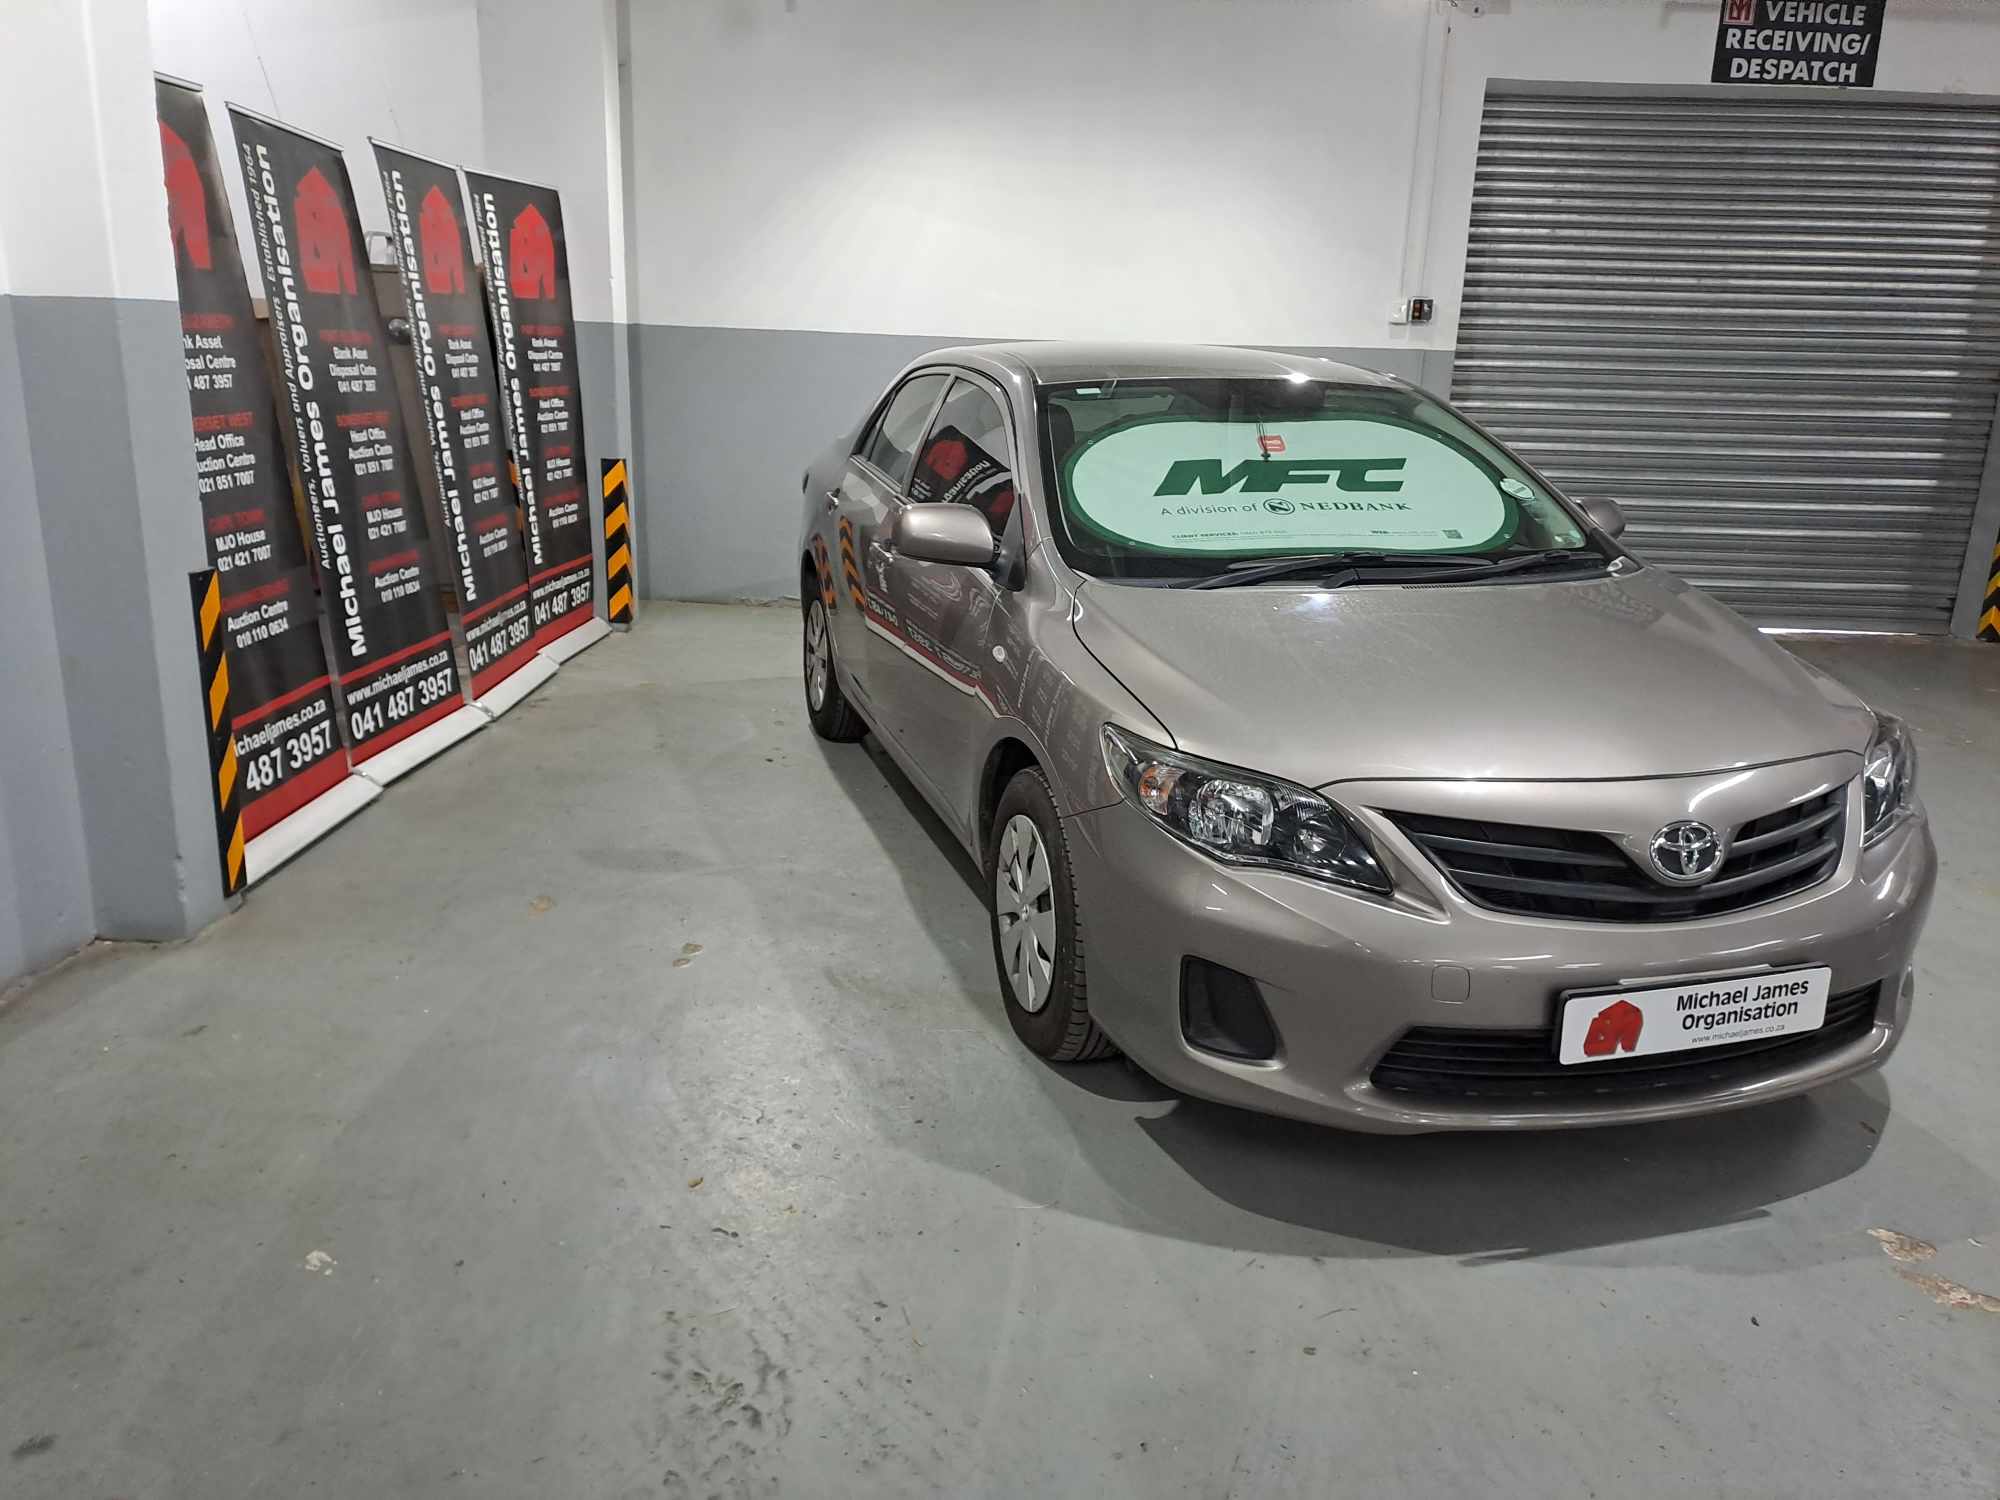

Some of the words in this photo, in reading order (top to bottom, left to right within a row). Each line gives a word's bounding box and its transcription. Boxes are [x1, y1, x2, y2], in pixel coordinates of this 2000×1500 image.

[1766, 1, 1866, 26] VEHICLE
[1725, 28, 1871, 55] RECEIVING/
[1730, 57, 1857, 83] DESPATCH
[251, 191, 276, 282] Established
[256, 144, 314, 390] Organisation
[392, 170, 436, 376] Organisation
[483, 193, 517, 370] Organisation
[195, 334, 223, 349] Asset
[272, 296, 295, 379] Appraisers
[193, 375, 210, 390] 487
[212, 374, 232, 389] 3957
[287, 382, 301, 412] and
[430, 385, 456, 481] James
[510, 377, 530, 461] James
[217, 433, 245, 449] Office
[226, 452, 256, 468] Centre
[295, 417, 312, 473] Valuers
[306, 401, 340, 514] James
[199, 477, 215, 493] 021
[216, 474, 233, 490] 851
[233, 470, 255, 486] 7007
[1153, 457, 1406, 496] MFC
[522, 467, 543, 565] Michael
[1160, 507, 1171, 516] A
[1176, 503, 1238, 515] division
[1242, 502, 1258, 512] of
[1300, 502, 1414, 512] NEDBANK
[215, 534, 236, 552] MJO
[236, 529, 266, 546] House
[217, 556, 233, 572] 021
[234, 550, 251, 567] 421
[251, 544, 271, 562] 7007
[447, 489, 477, 602] Michael
[327, 524, 368, 657] Michael
[534, 601, 551, 624] 041
[552, 591, 568, 615] 487
[571, 581, 590, 607] 3957
[227, 611, 261, 632] Auction
[469, 641, 489, 671] 041
[490, 629, 507, 657] 487
[508, 615, 529, 646] 3957
[347, 650, 449, 705] www.michaeljames.co.za
[351, 702, 383, 740] 041
[387, 686, 414, 720] 487
[418, 667, 453, 705] 3957
[246, 747, 282, 791] 487
[286, 719, 331, 769] 3957
[1676, 986, 1749, 1011] Michael
[1752, 980, 1809, 1001] James
[1682, 1001, 1798, 1030] Organisation
[1691, 1024, 1785, 1043] www.michaeljames.co.za
